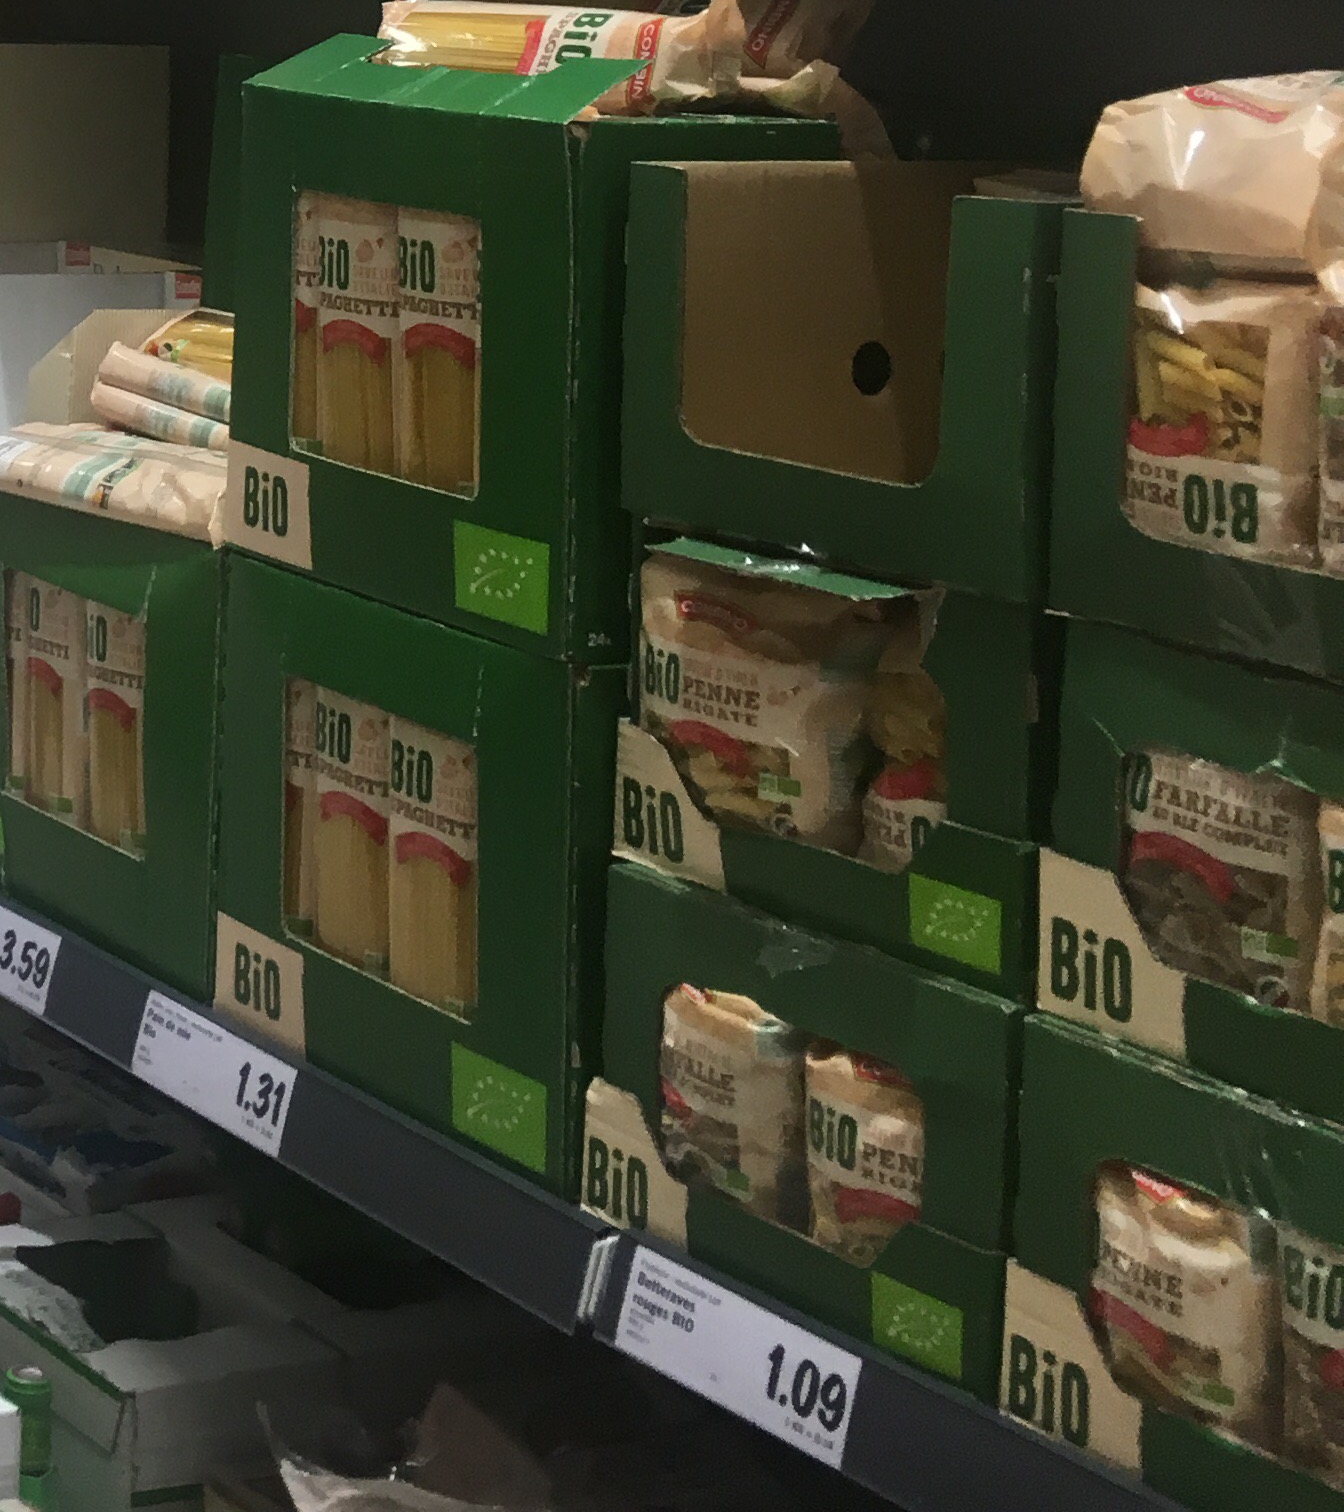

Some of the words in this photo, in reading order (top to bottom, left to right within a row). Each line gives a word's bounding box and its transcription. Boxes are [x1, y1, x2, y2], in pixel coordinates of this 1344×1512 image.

[682, 675, 761, 711] PENNE
[1152, 778, 1291, 837] FARFALLE
[235, 1060, 287, 1127] 1.31
[765, 1343, 848, 1433] 1.09
